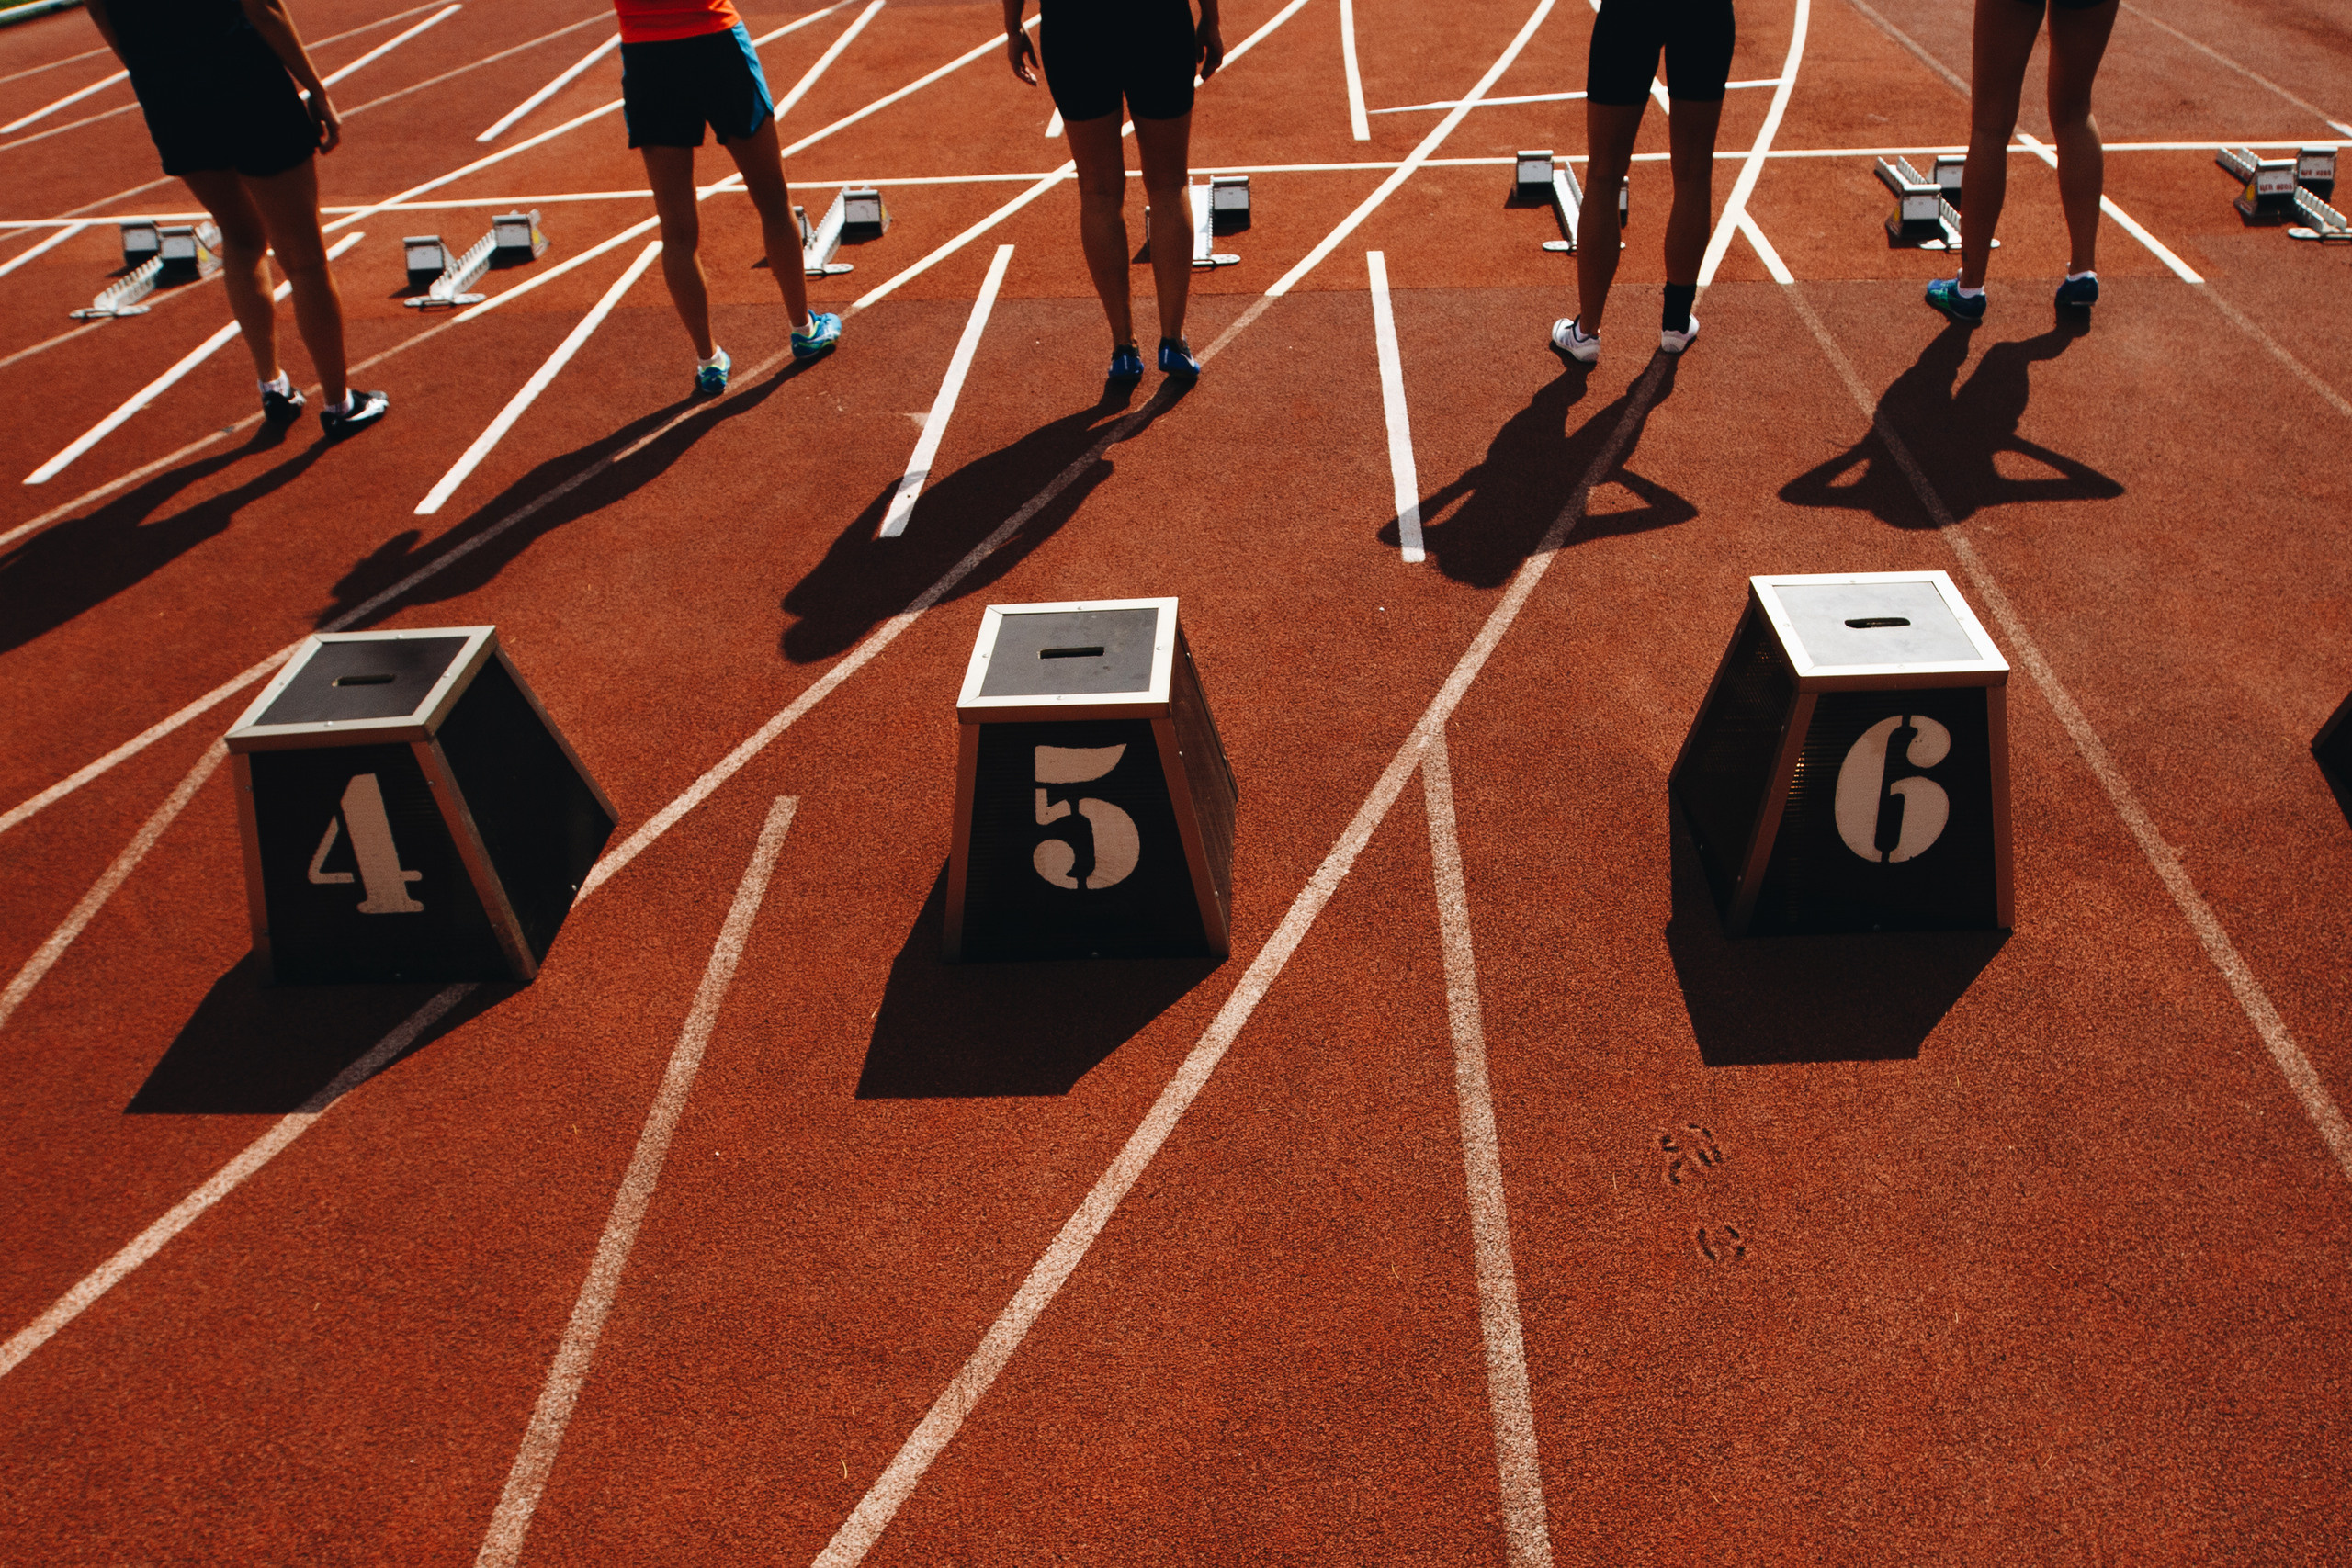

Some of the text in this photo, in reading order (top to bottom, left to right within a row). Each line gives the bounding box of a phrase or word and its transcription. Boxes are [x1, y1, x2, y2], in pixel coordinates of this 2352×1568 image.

[307, 773, 424, 914] 4
[1033, 743, 1140, 890] 5
[1835, 715, 1951, 863] 6
